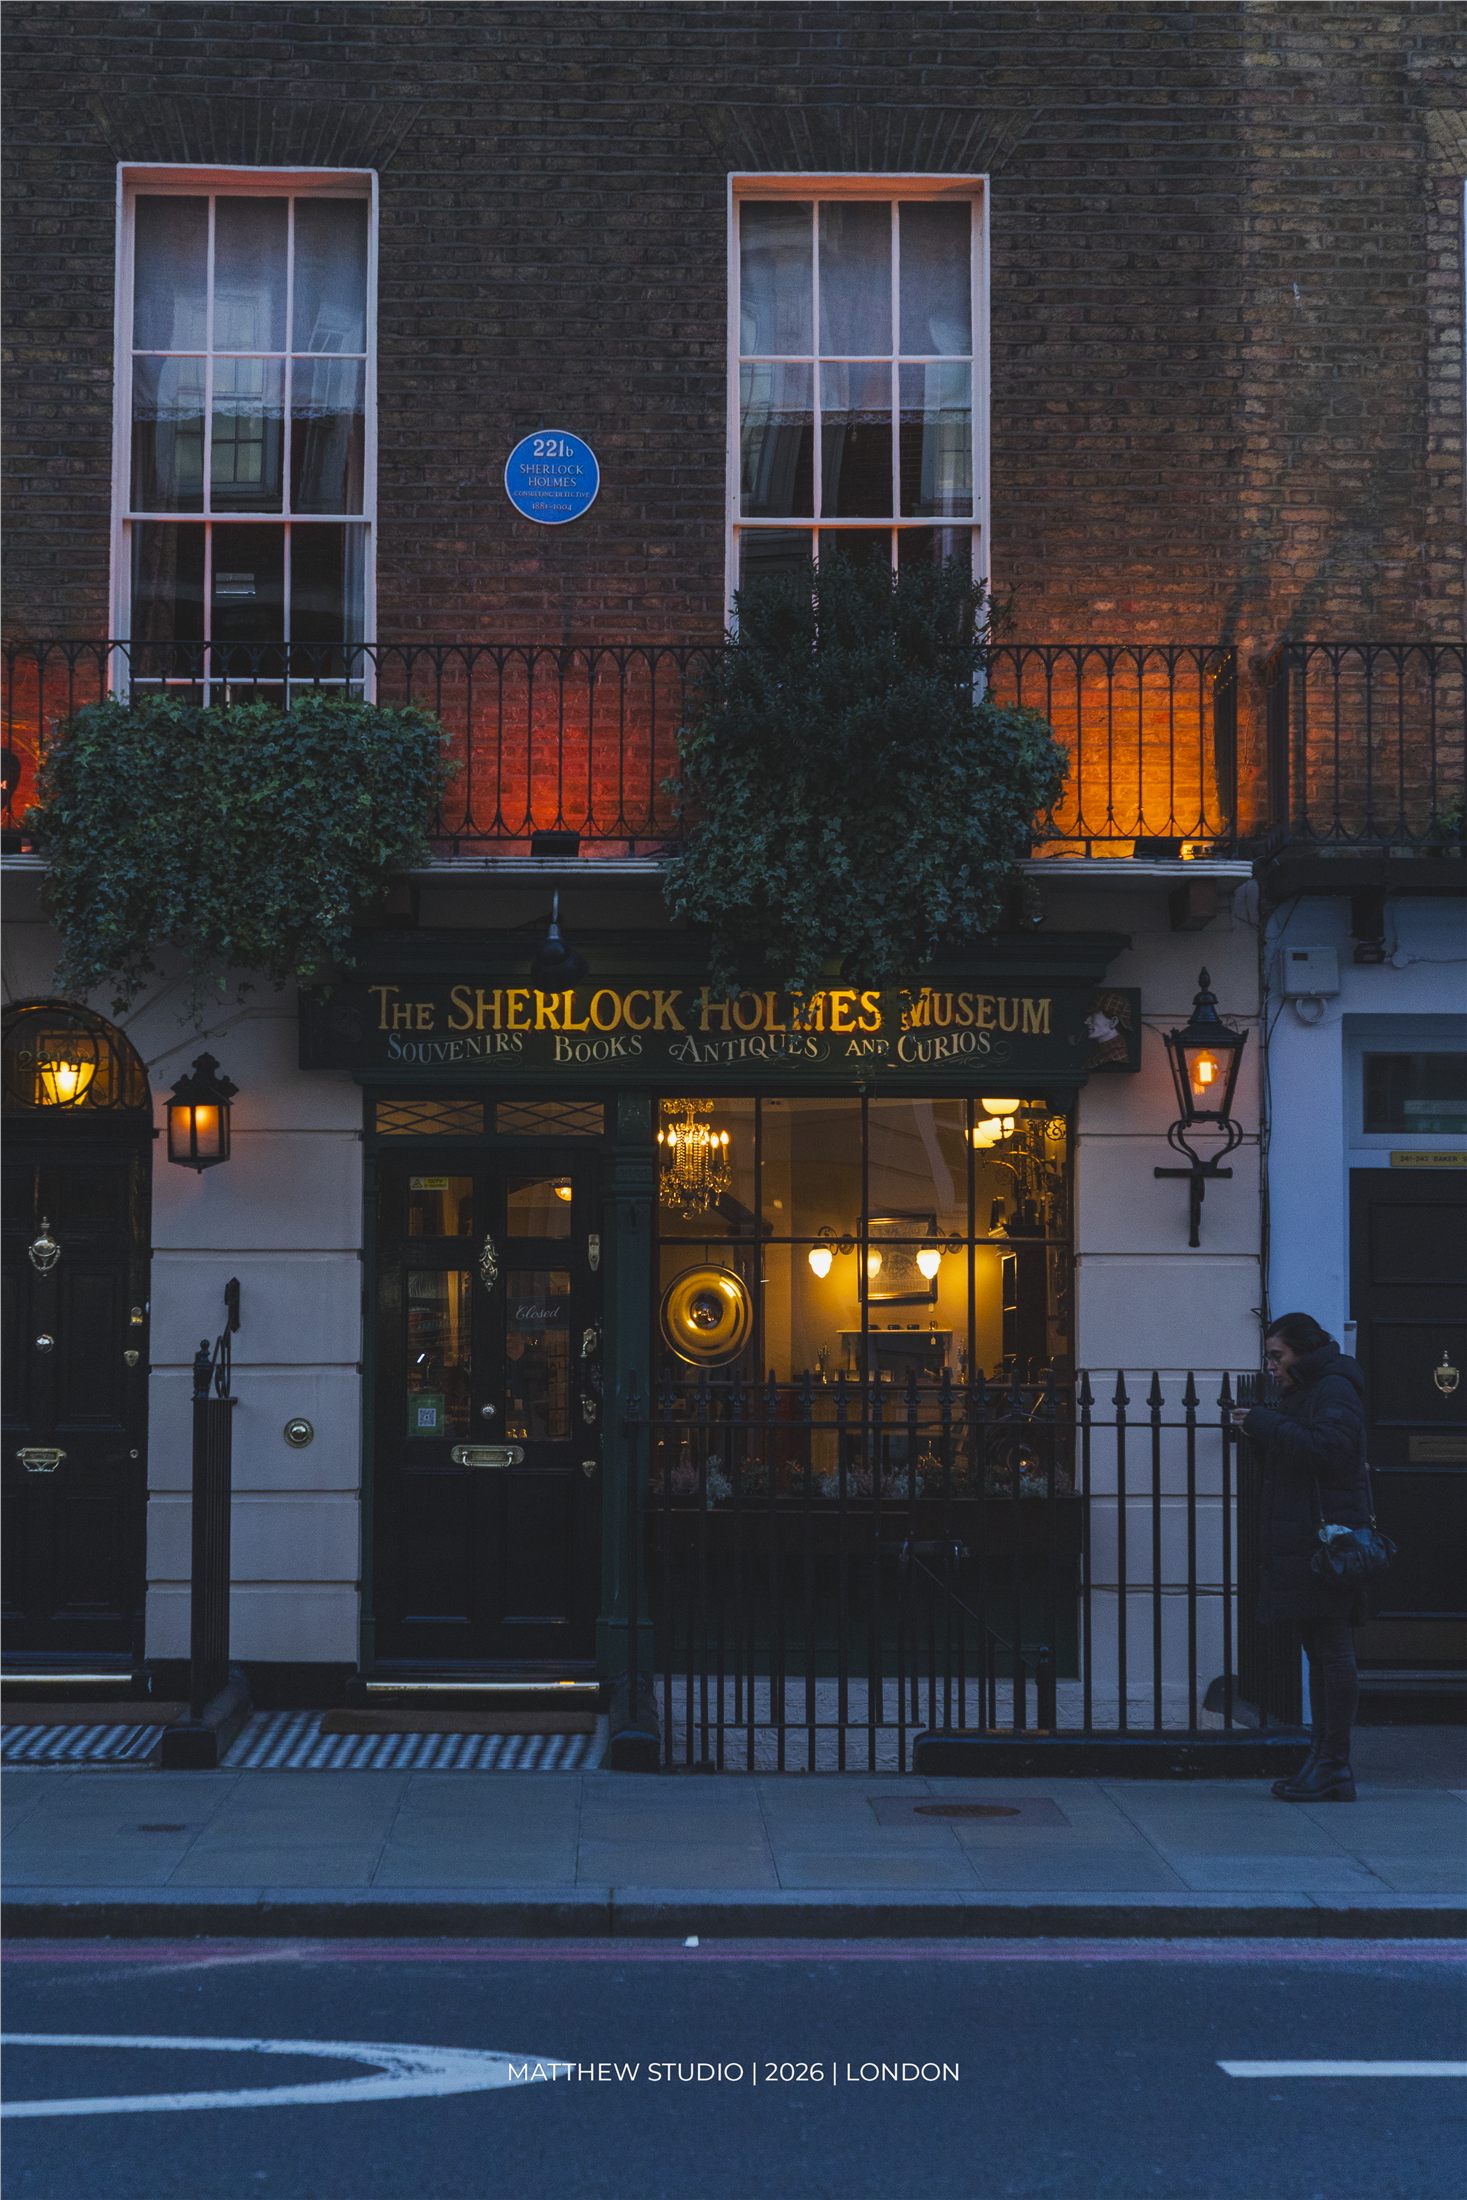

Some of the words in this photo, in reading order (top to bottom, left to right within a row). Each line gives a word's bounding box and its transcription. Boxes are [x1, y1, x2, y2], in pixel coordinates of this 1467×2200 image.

[533, 439, 574, 457] 221b
[520, 464, 584, 475] SHERLOCK
[528, 477, 577, 487] HOLMES
[532, 502, 572, 511] 1881-1904
[368, 984, 436, 1030] THE
[448, 984, 685, 1032] SHERLOCK
[699, 986, 883, 1034] HOLMES
[899, 987, 1051, 1035] MUSEUM
[387, 1032, 524, 1064] SOUVENIRS
[553, 1034, 643, 1064] BOOKS
[675, 1034, 818, 1064] ANTIQUES
[845, 1038, 889, 1057] AND
[897, 1031, 992, 1063] CURIOS
[515, 1303, 561, 1321] Closed
